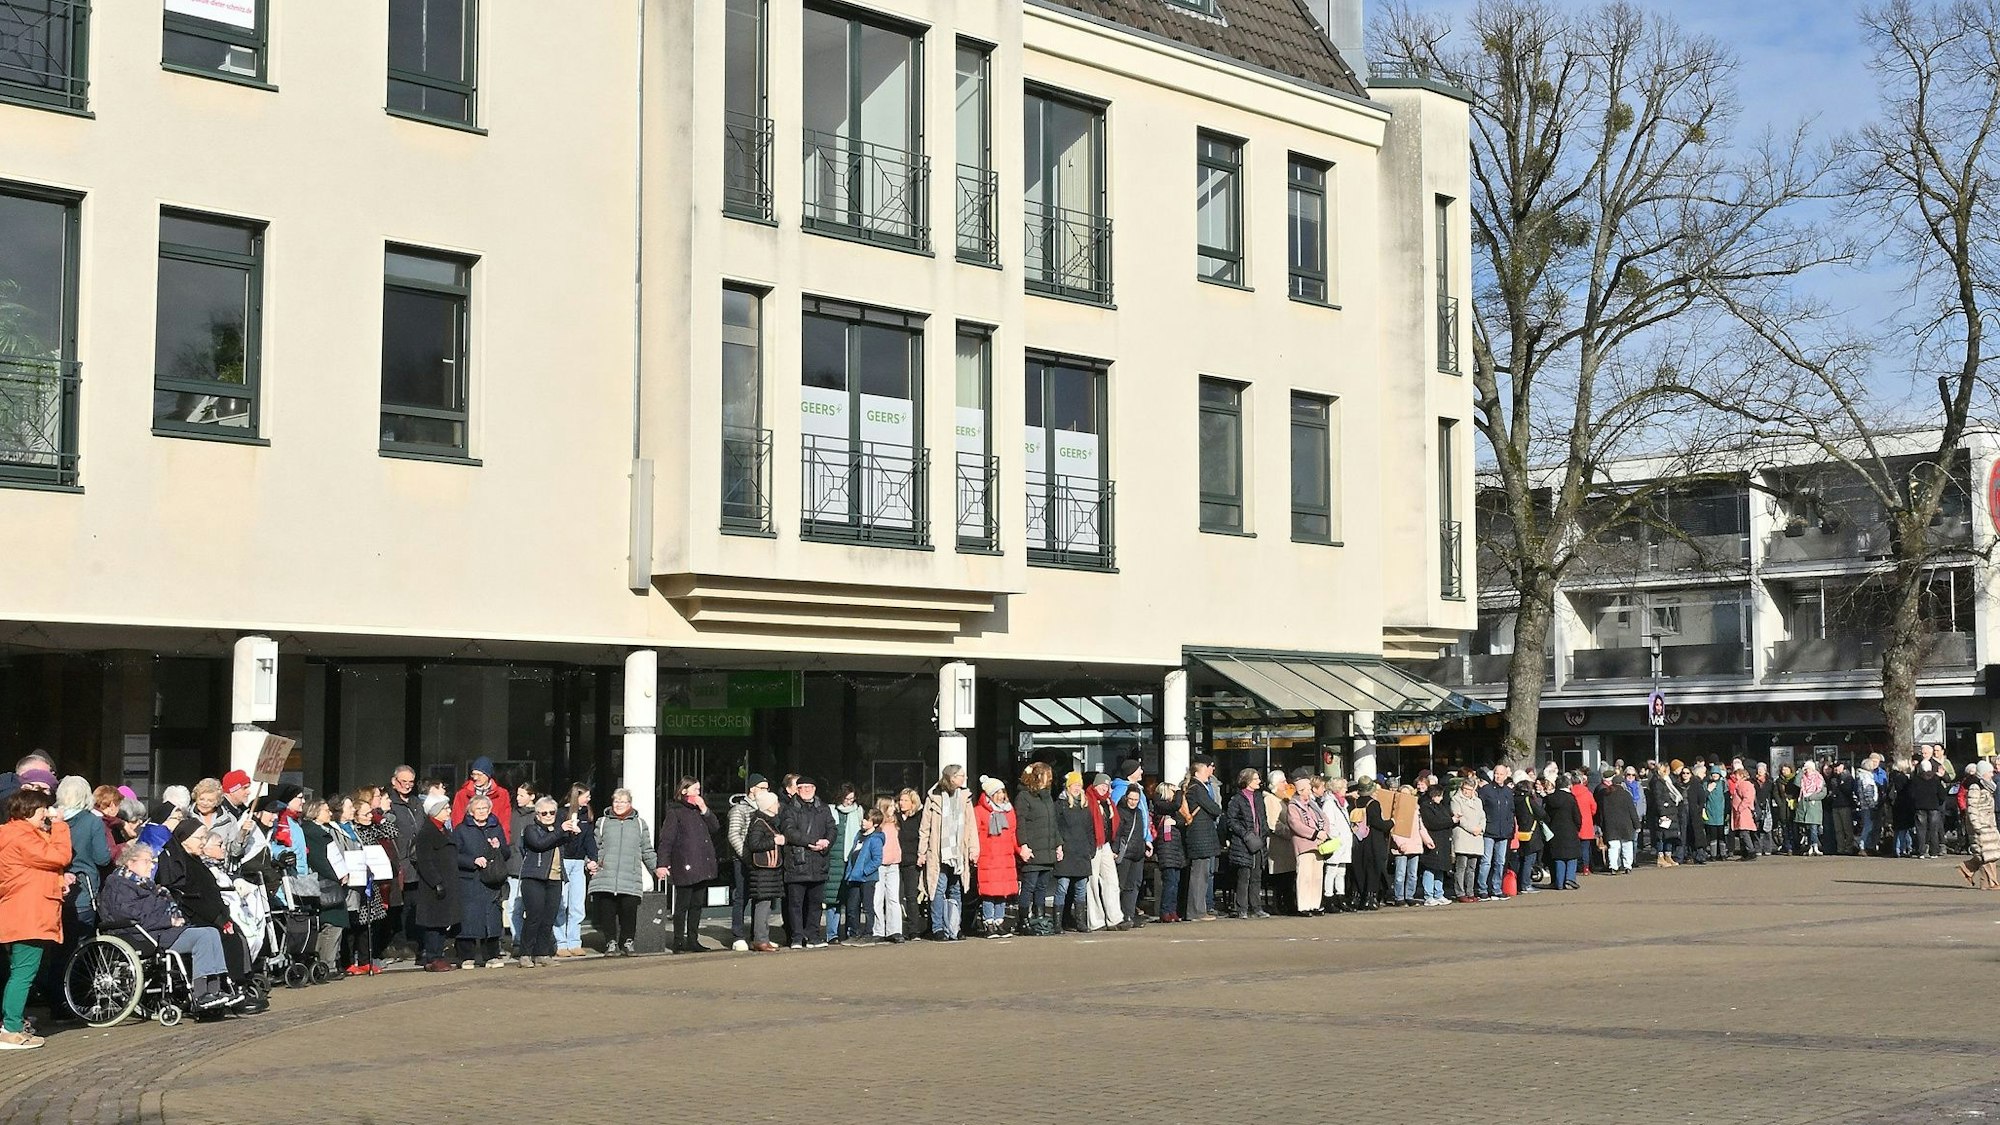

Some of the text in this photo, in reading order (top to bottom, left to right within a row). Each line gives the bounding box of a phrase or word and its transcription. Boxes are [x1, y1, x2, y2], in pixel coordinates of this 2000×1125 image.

[801, 401, 835, 416] GEERS
[867, 410, 900, 424] GEERS
[1060, 447, 1088, 460] GEERS
[665, 714, 705, 728] GUTES
